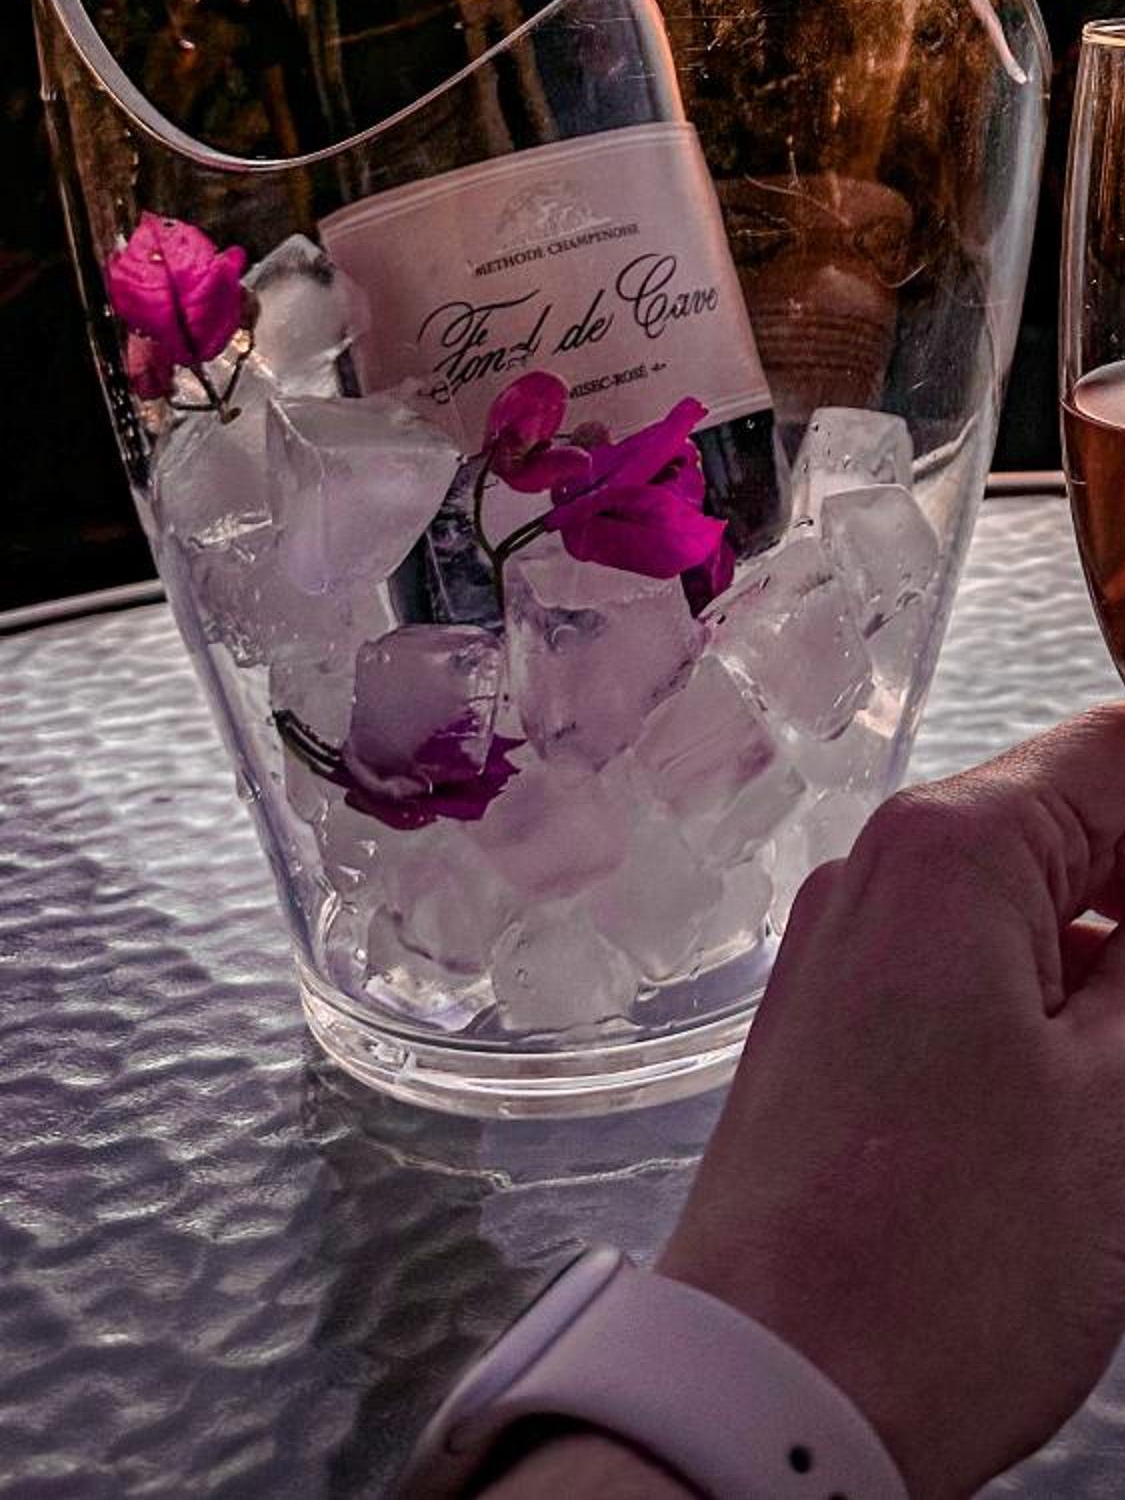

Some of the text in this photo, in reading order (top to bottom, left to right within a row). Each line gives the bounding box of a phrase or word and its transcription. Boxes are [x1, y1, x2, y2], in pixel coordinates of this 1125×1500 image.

[474, 222, 640, 277] METHODE CHAMPENOISE
[416, 252, 718, 404] Fond de Cave
